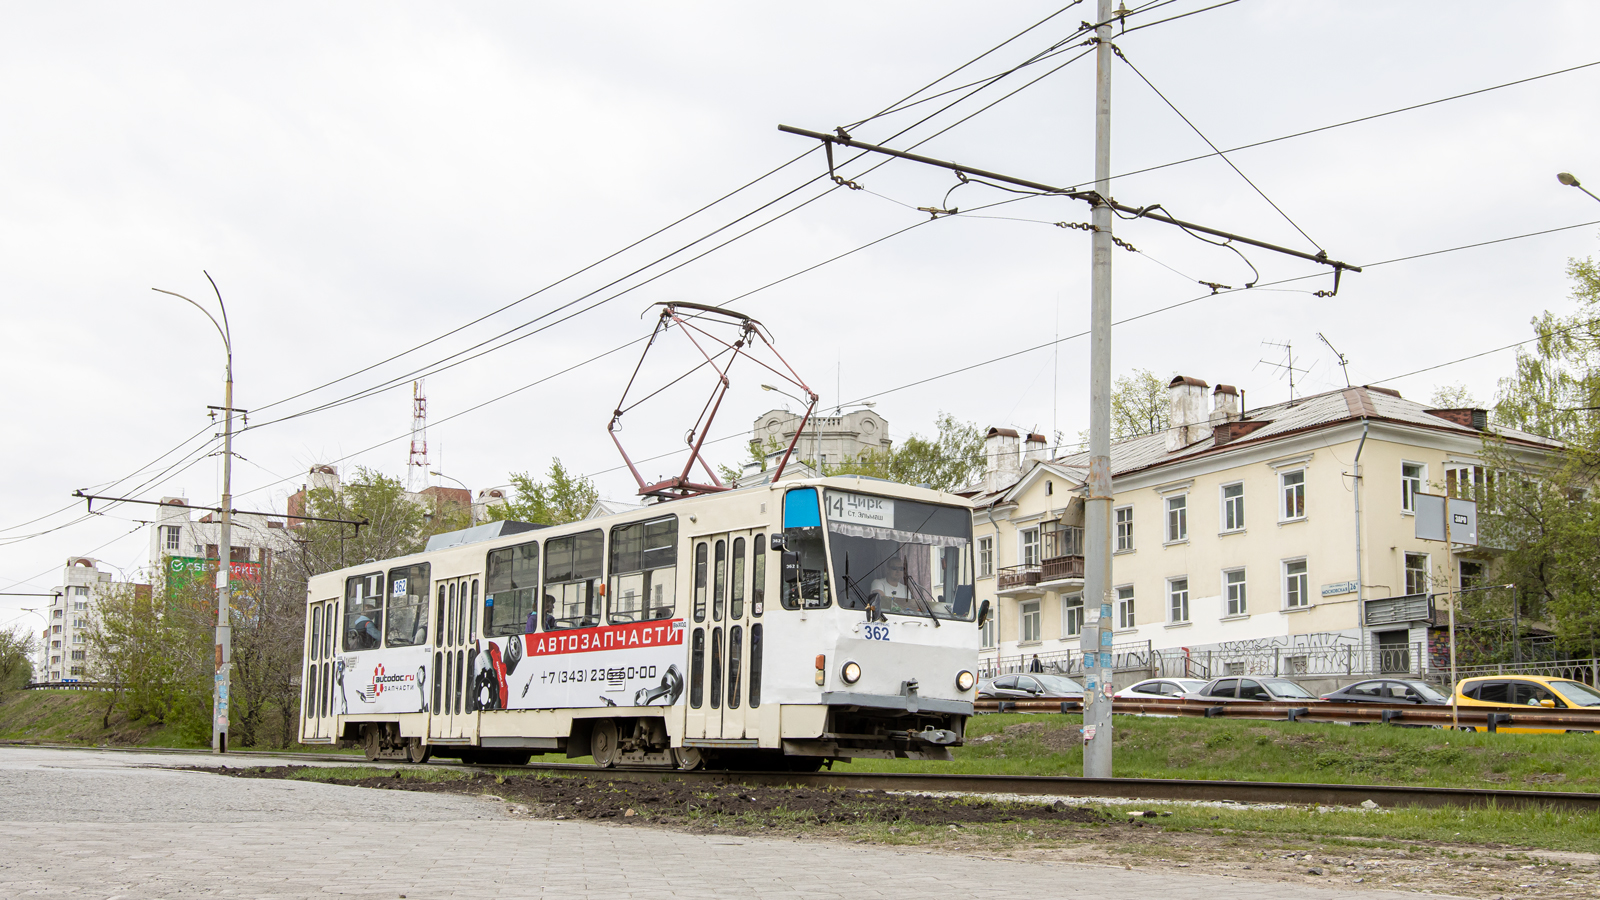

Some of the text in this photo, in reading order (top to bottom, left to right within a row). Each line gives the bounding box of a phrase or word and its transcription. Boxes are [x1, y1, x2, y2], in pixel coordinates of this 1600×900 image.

[826, 495, 844, 518] 14
[847, 494, 883, 511] Цирк
[395, 580, 405, 593] 362
[536, 626, 679, 653] АВТОЗАПЧАСТИ
[865, 625, 890, 641] 362
[375, 674, 414, 683] autodoc.ru
[558, 669, 587, 684] (343)
